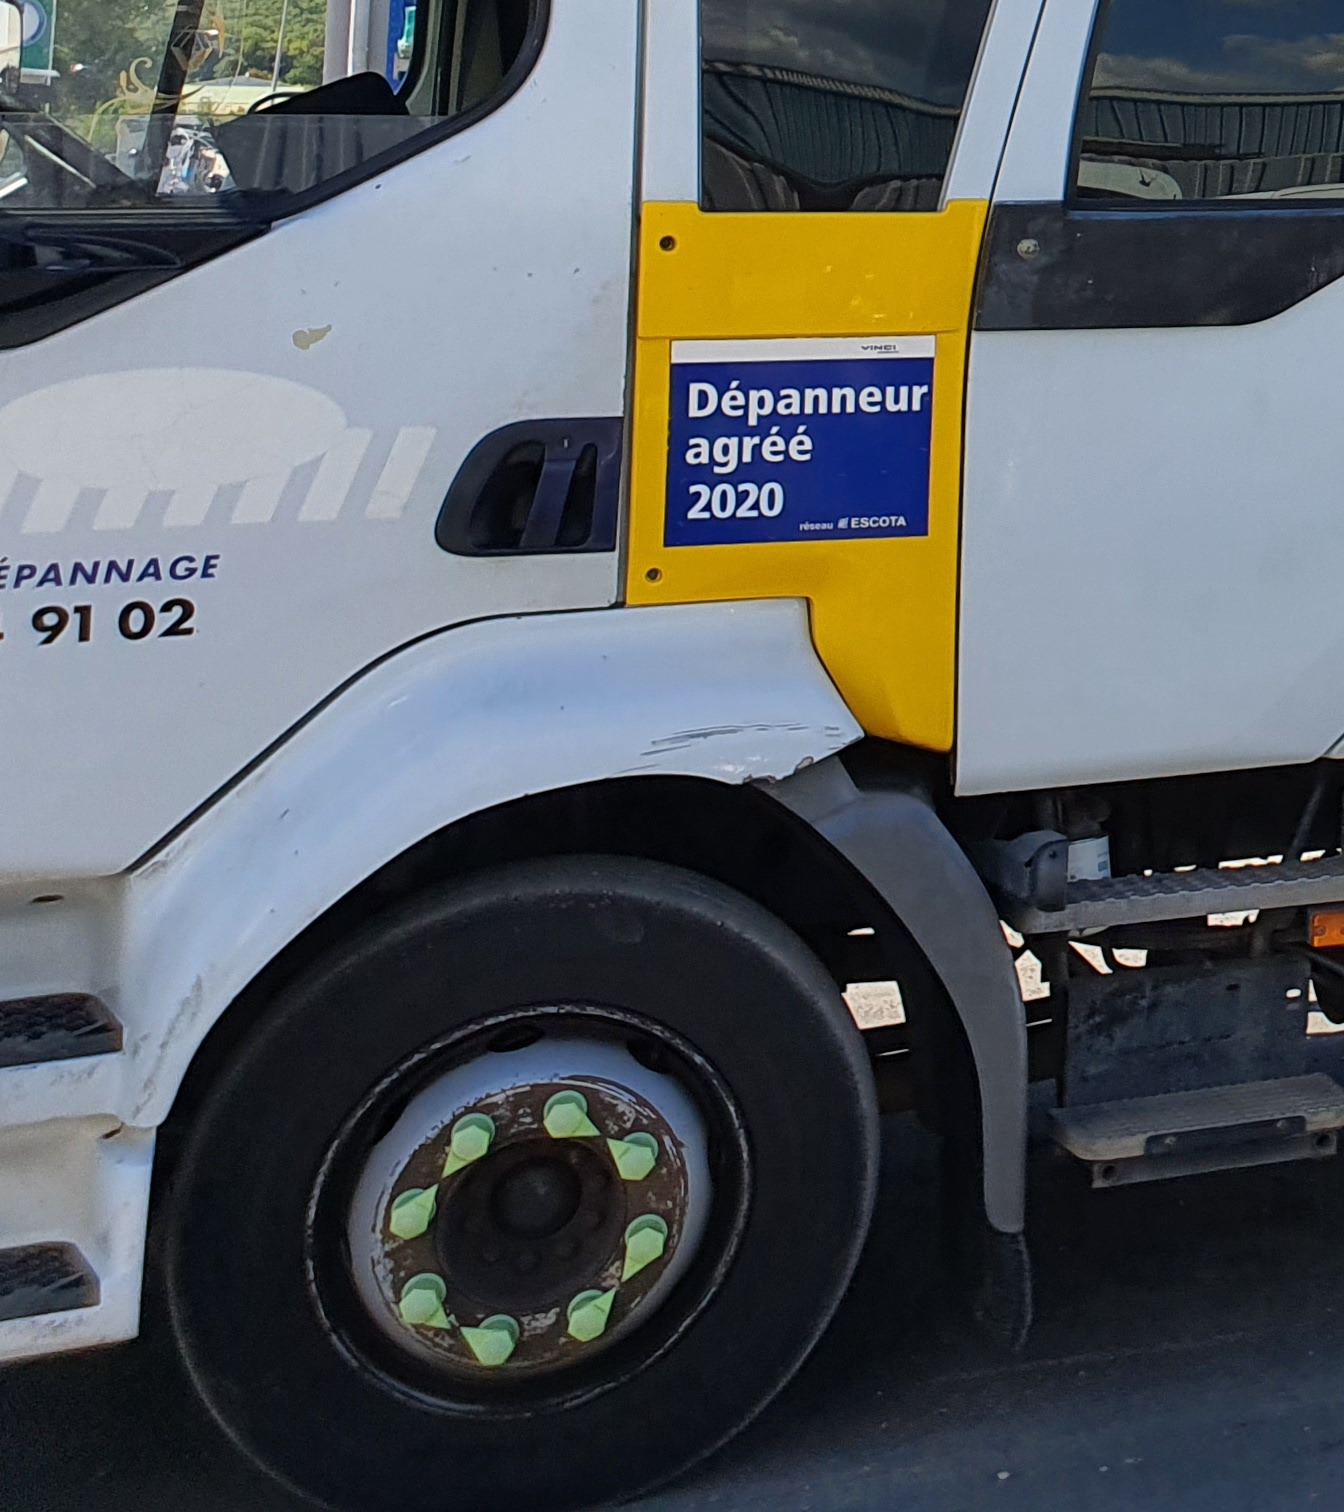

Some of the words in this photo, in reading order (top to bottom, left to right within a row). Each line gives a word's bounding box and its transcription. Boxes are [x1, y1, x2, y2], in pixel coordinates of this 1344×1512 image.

[686, 380, 930, 427] Dépanneur
[684, 425, 814, 475] agréé
[686, 481, 785, 520] 2020
[798, 521, 834, 532] réseau
[850, 515, 907, 529] ESCOTA
[31, 604, 93, 647] 91
[118, 597, 196, 641] 02
